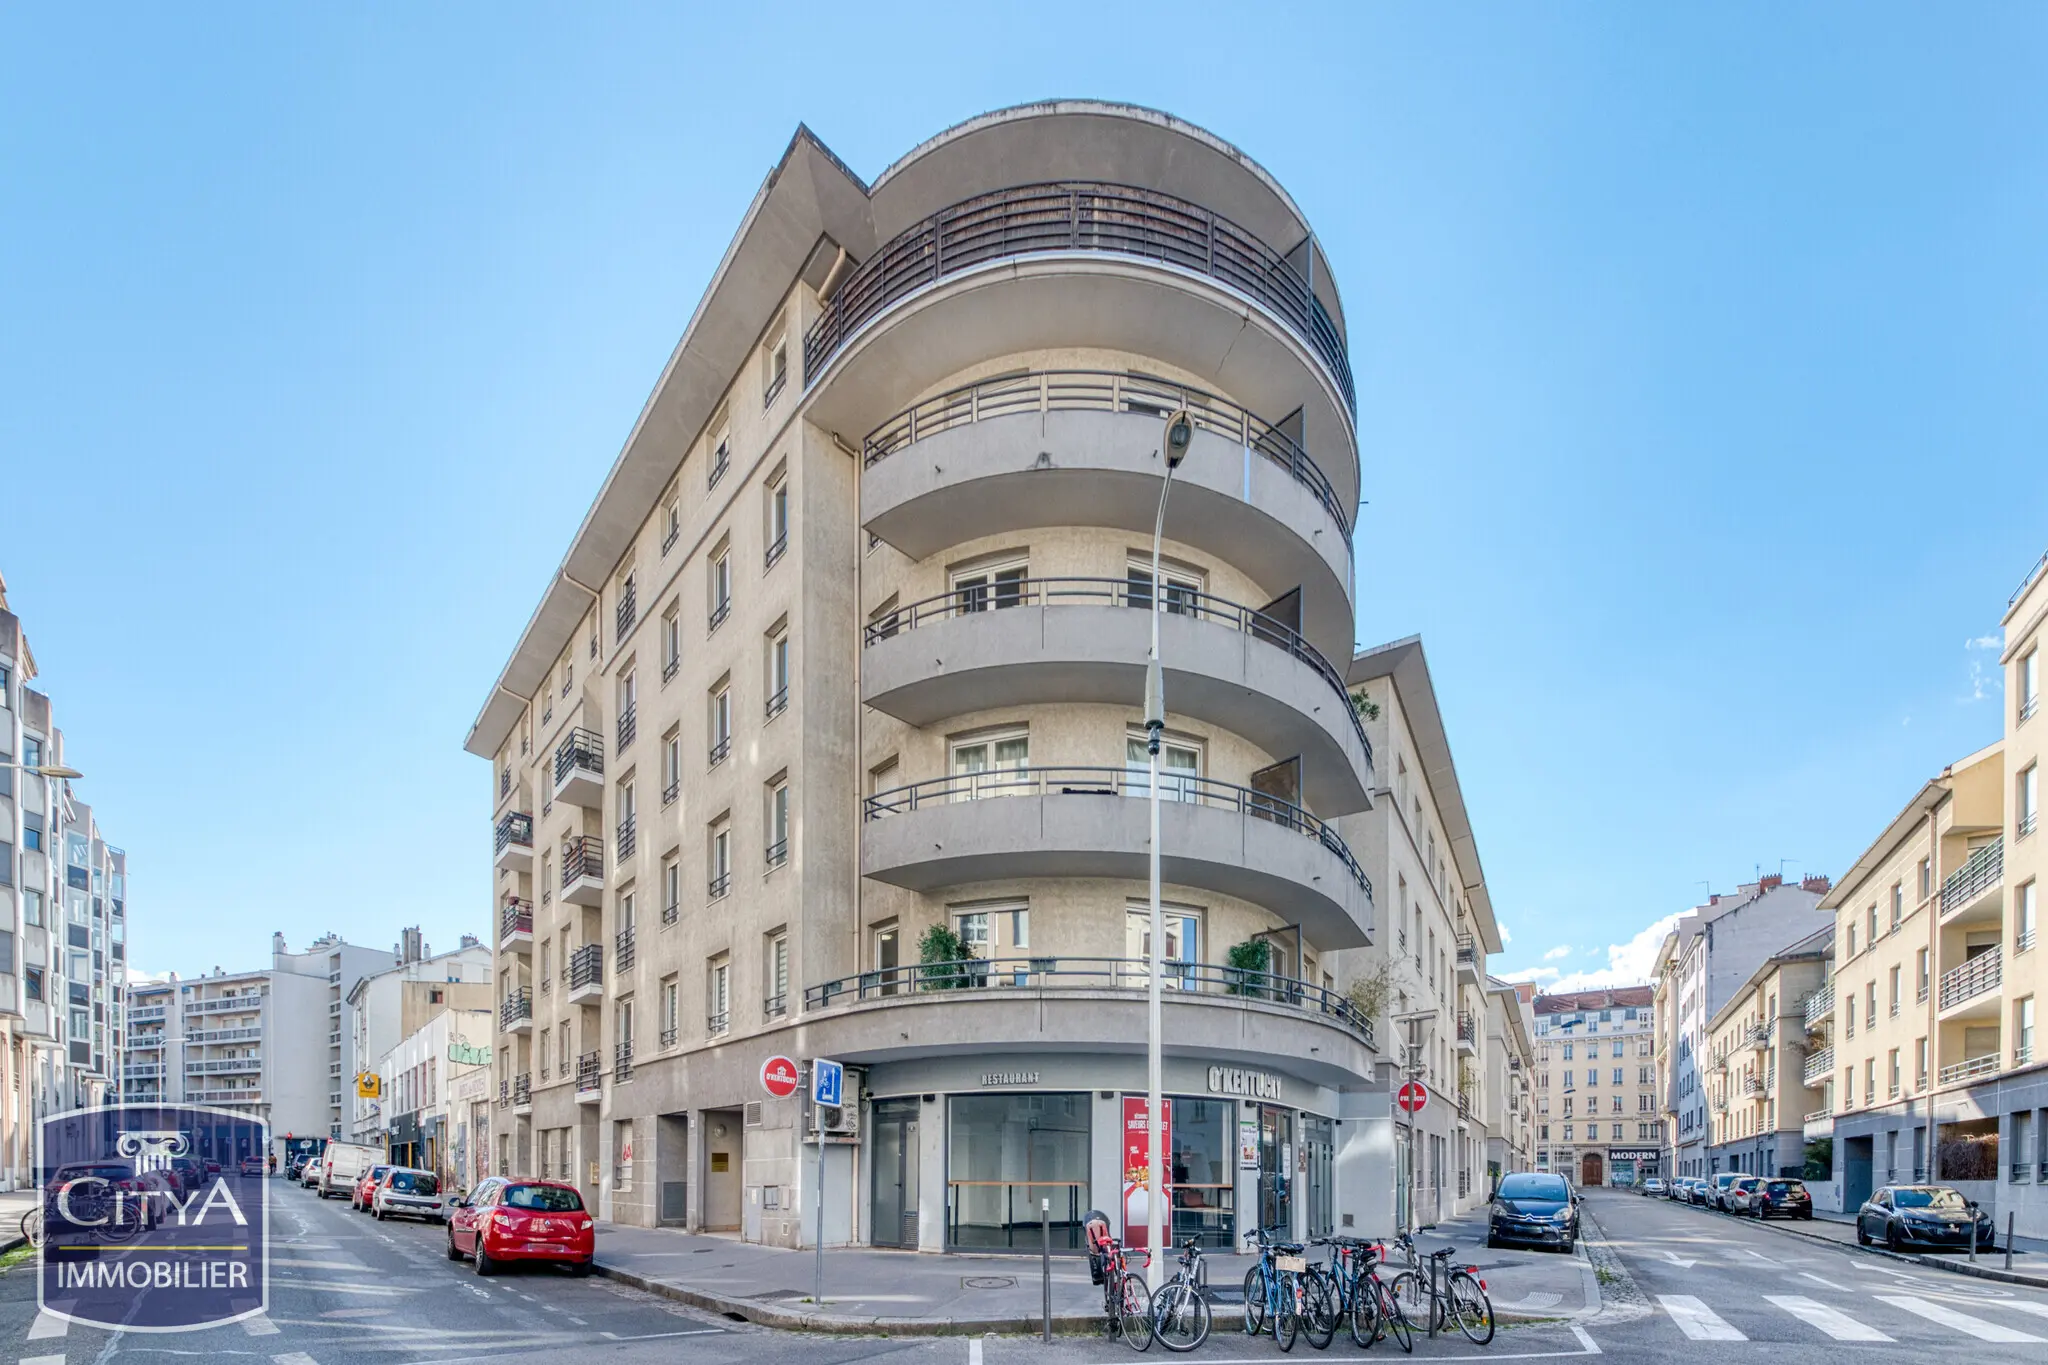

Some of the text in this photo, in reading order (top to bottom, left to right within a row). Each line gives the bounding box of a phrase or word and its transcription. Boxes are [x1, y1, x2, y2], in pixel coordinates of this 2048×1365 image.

[981, 1072, 1040, 1085] RESTAURANT
[1208, 1066, 1281, 1099] O'KENTUCKY
[1610, 1151, 1656, 1160] MODERN
